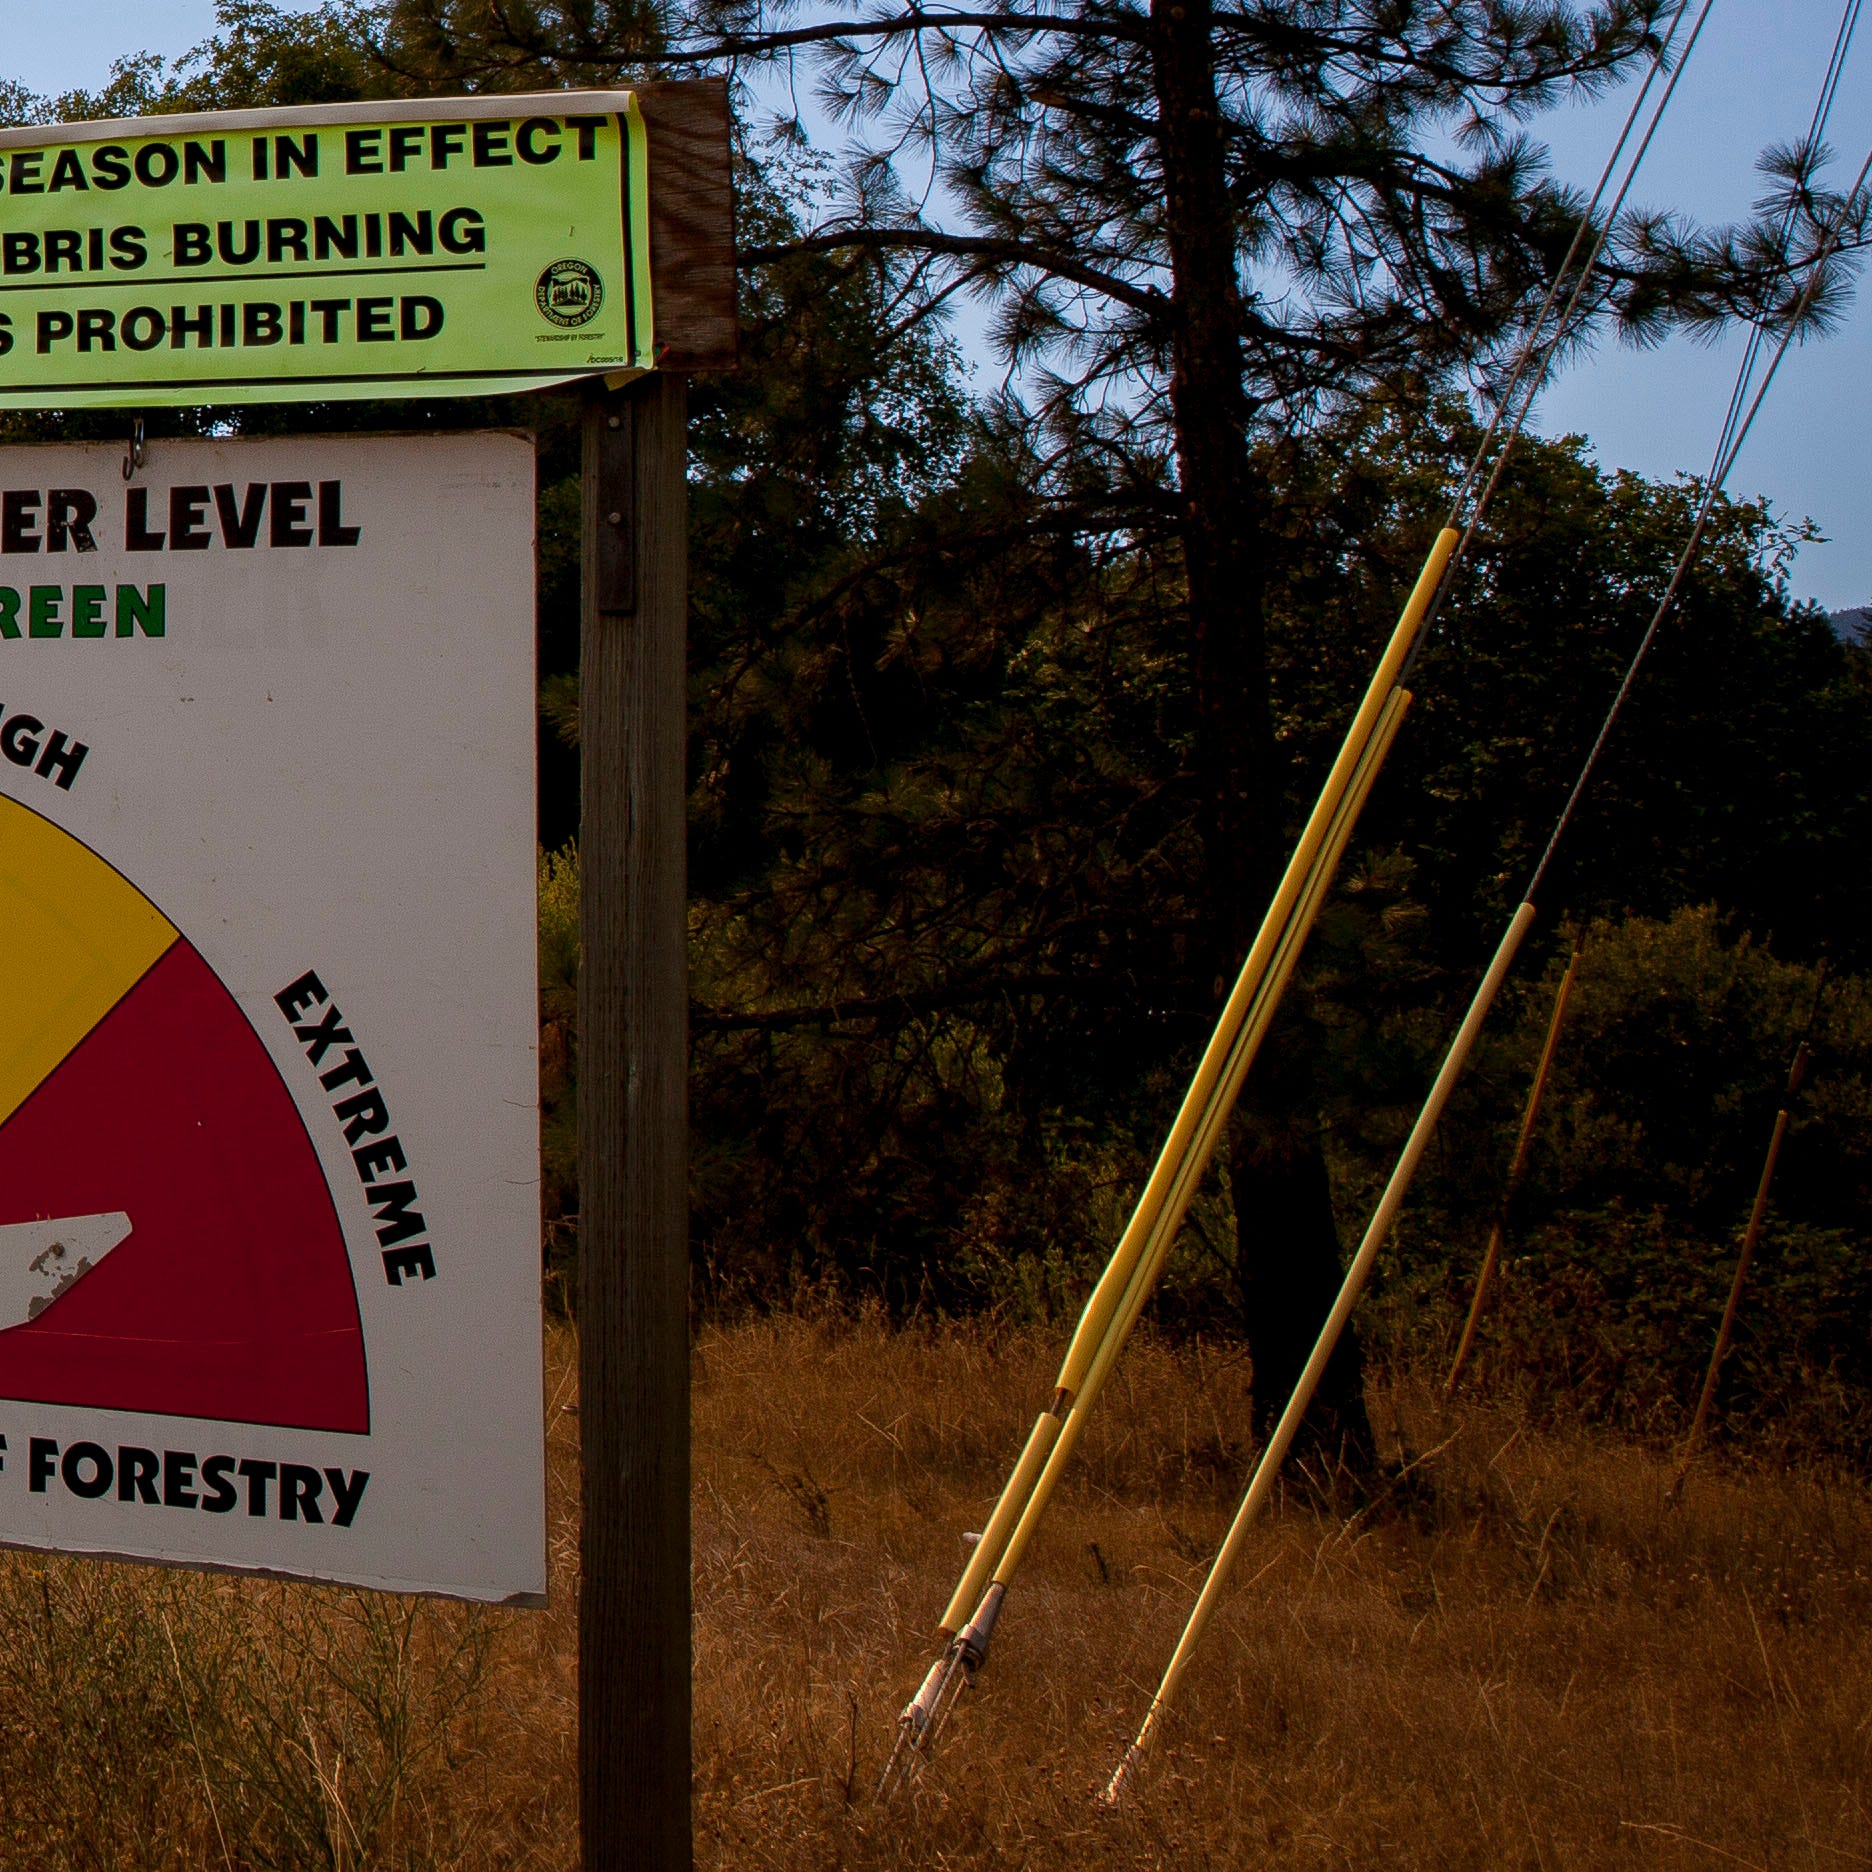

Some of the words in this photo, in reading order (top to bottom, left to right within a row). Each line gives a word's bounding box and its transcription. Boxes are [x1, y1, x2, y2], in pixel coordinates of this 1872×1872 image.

[252, 131, 318, 181] IN
[345, 115, 610, 176] EFFECT
[173, 207, 486, 268] BURNING
[550, 261, 589, 276] OREGON
[36, 295, 444, 354] PROHIBITED
[570, 317, 583, 326] OF
[125, 479, 361, 552] LEVEL
[272, 969, 438, 1287] EXTREME
[29, 1437, 371, 1528] FORESTRY
